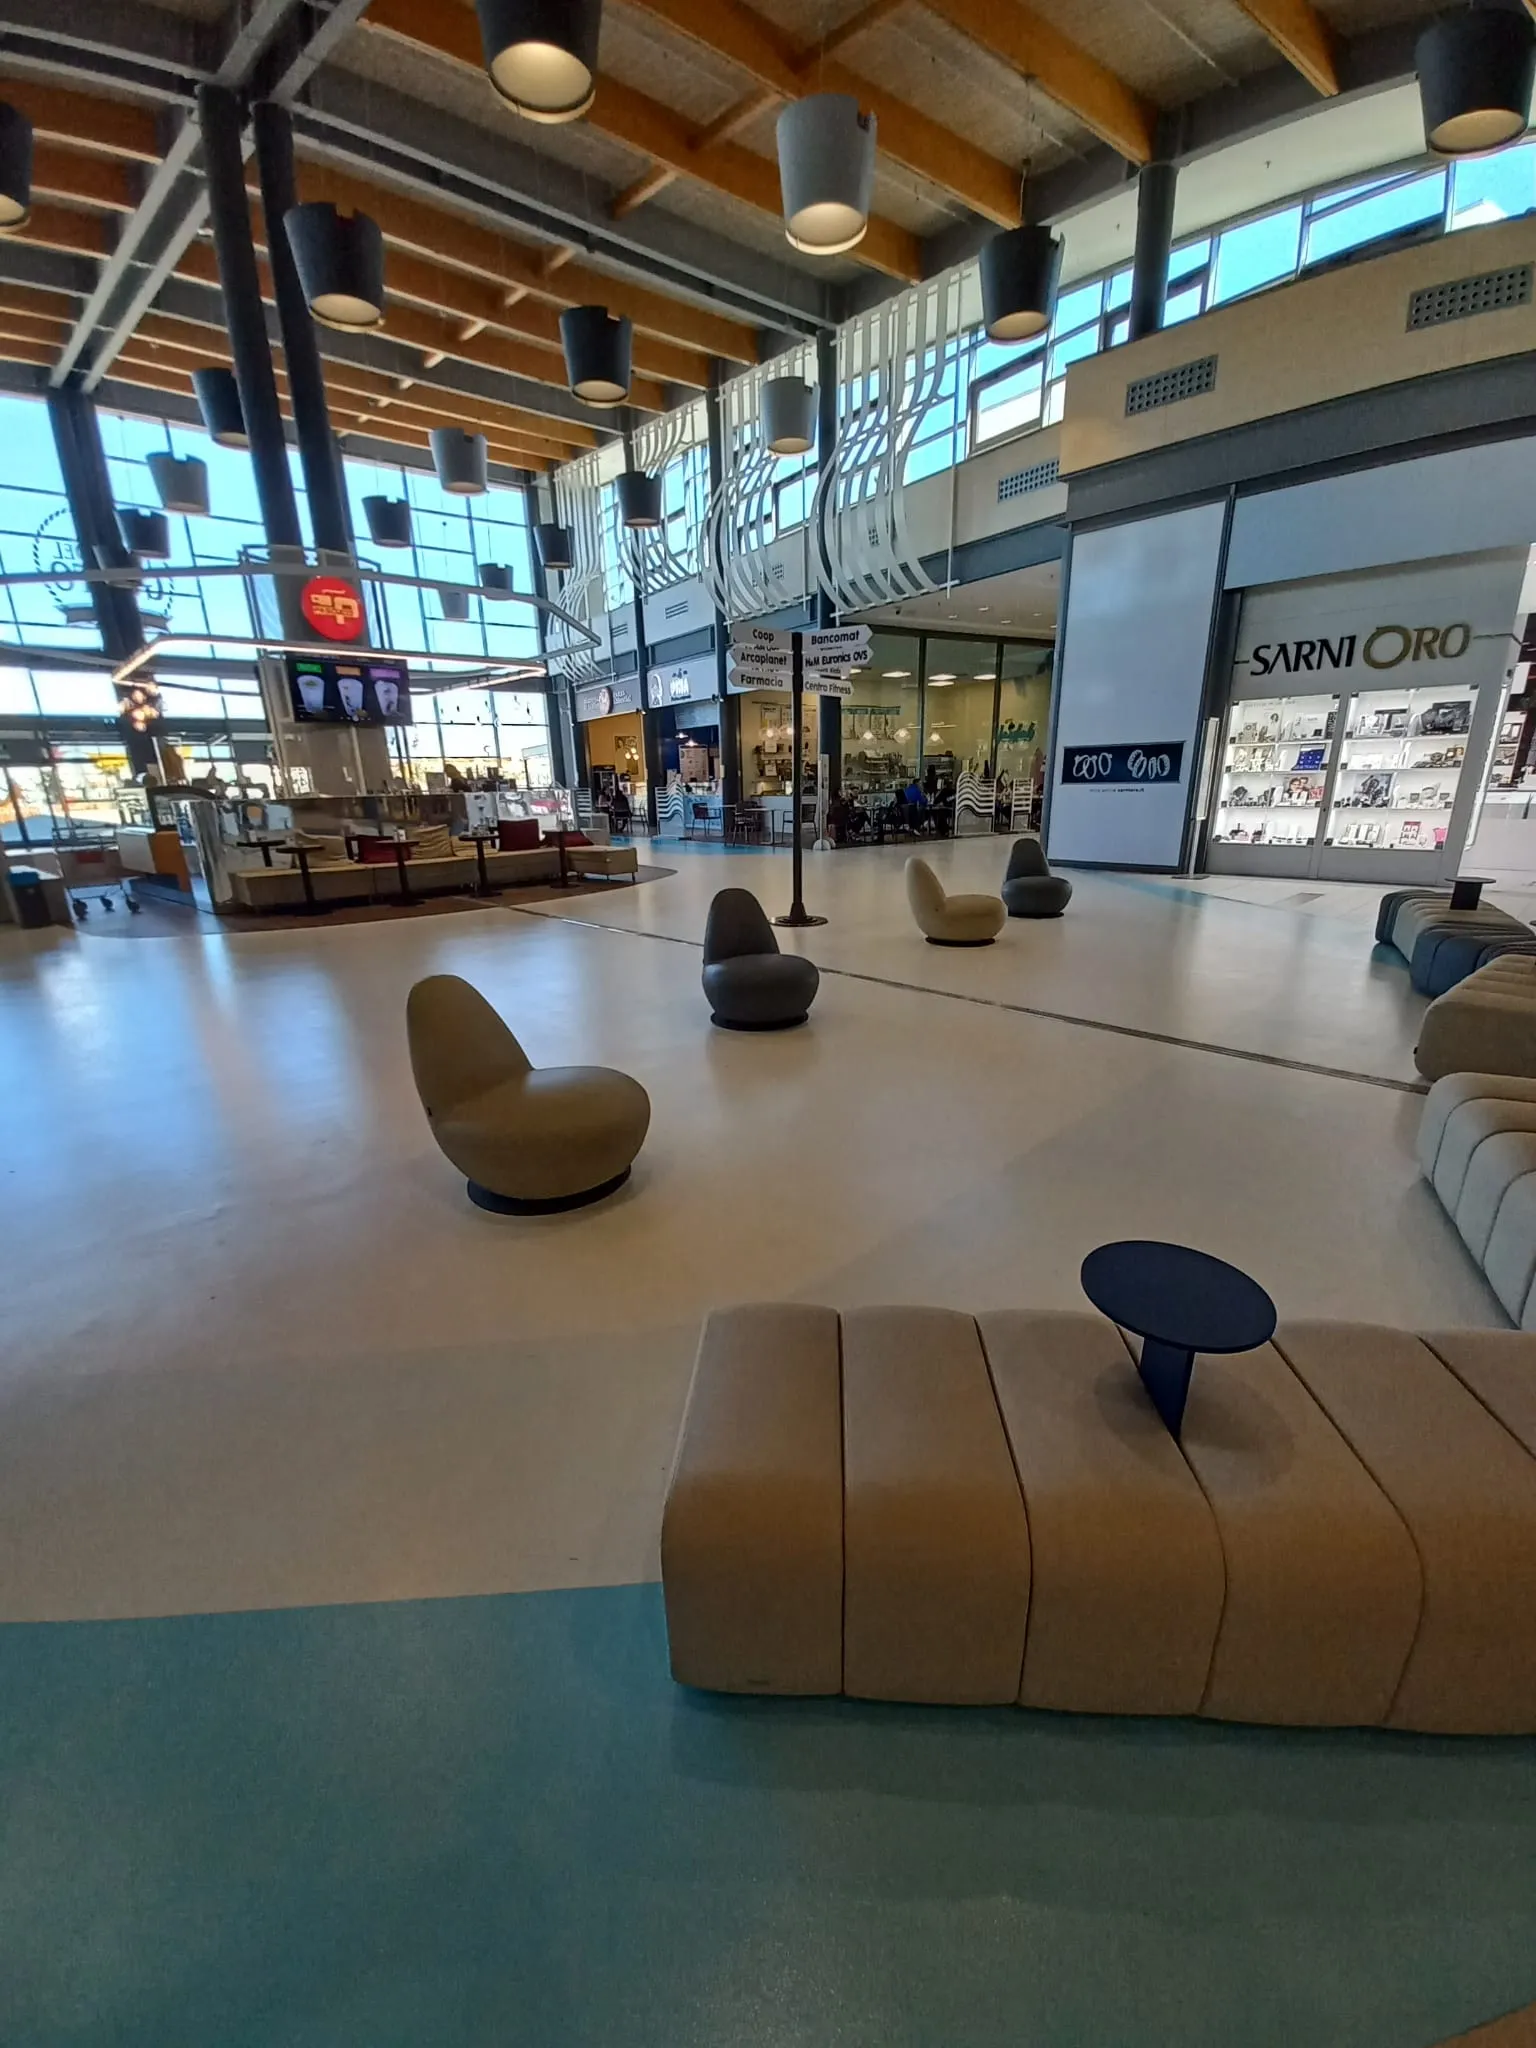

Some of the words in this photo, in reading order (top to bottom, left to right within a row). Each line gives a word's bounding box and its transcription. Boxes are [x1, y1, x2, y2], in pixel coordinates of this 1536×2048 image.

[752, 628, 775, 642] Coop
[811, 630, 860, 645] Bancomat
[1249, 634, 1358, 677] SARNI
[1361, 622, 1472, 671] ORO
[740, 651, 787, 666] Arcaplanet
[822, 653, 851, 666] Euronics
[853, 649, 868, 661] OVS
[740, 674, 783, 687] Farmacia
[804, 680, 828, 692] Centro
[829, 683, 852, 695] Fitness
